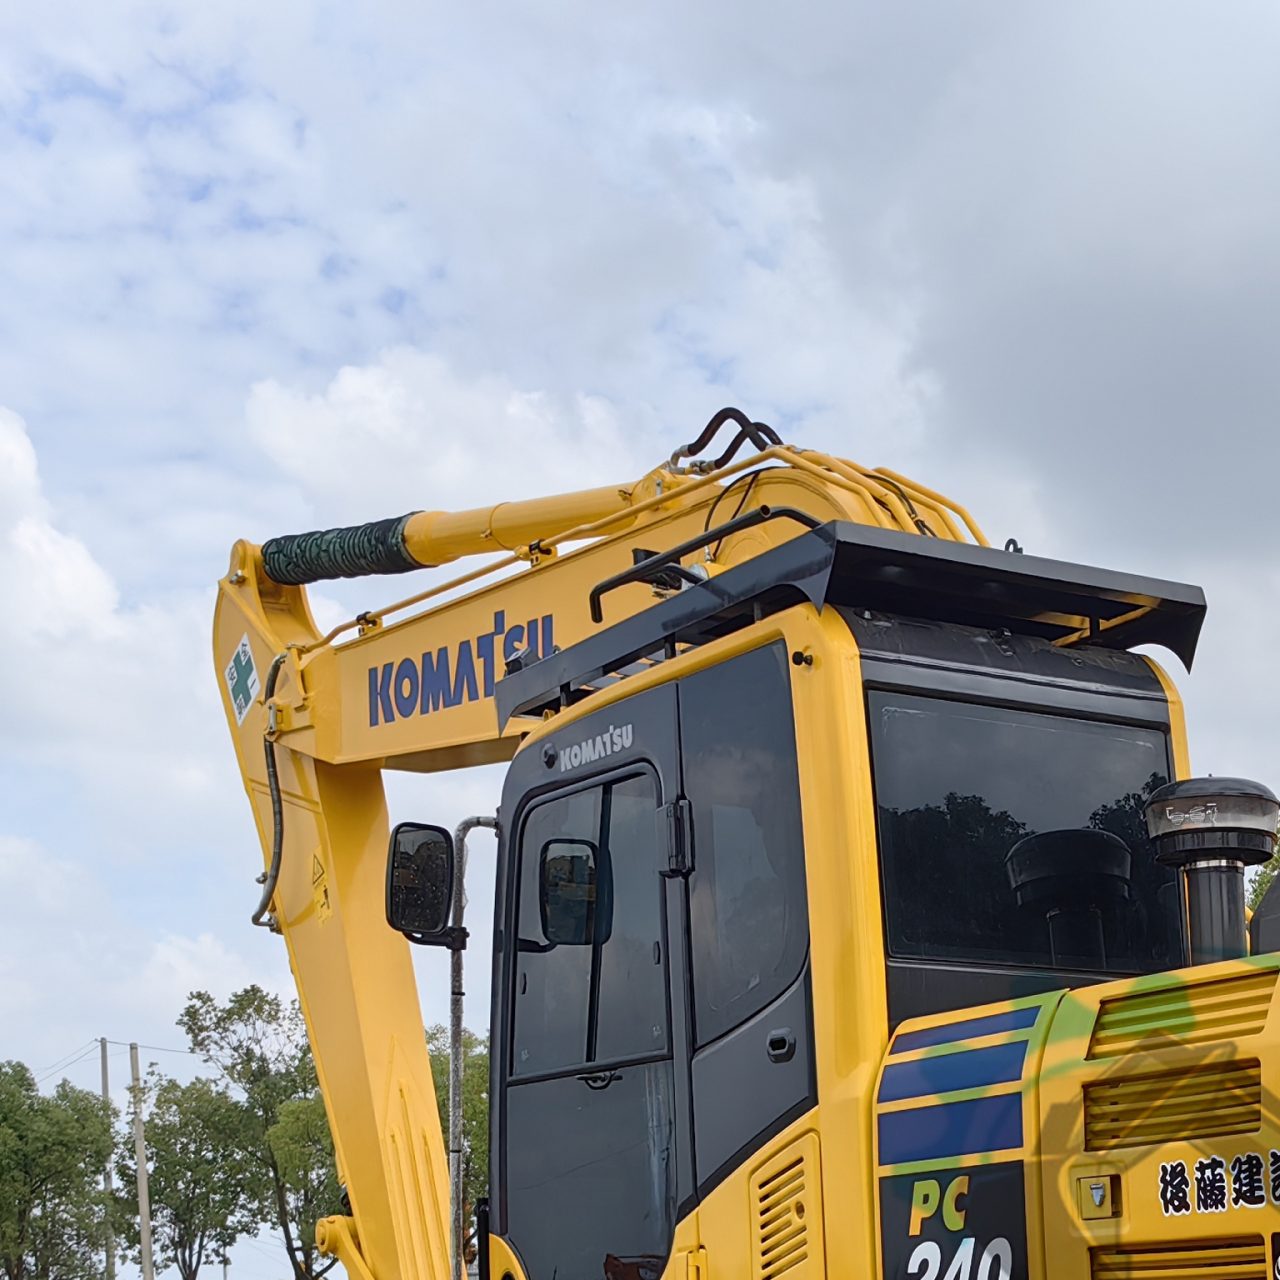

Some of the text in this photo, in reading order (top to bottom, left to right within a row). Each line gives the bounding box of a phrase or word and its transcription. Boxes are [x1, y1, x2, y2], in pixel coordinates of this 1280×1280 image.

[368, 610, 553, 727] KOMATSU
[560, 724, 633, 772] KOMATSU
[909, 1175, 969, 1236] PC
